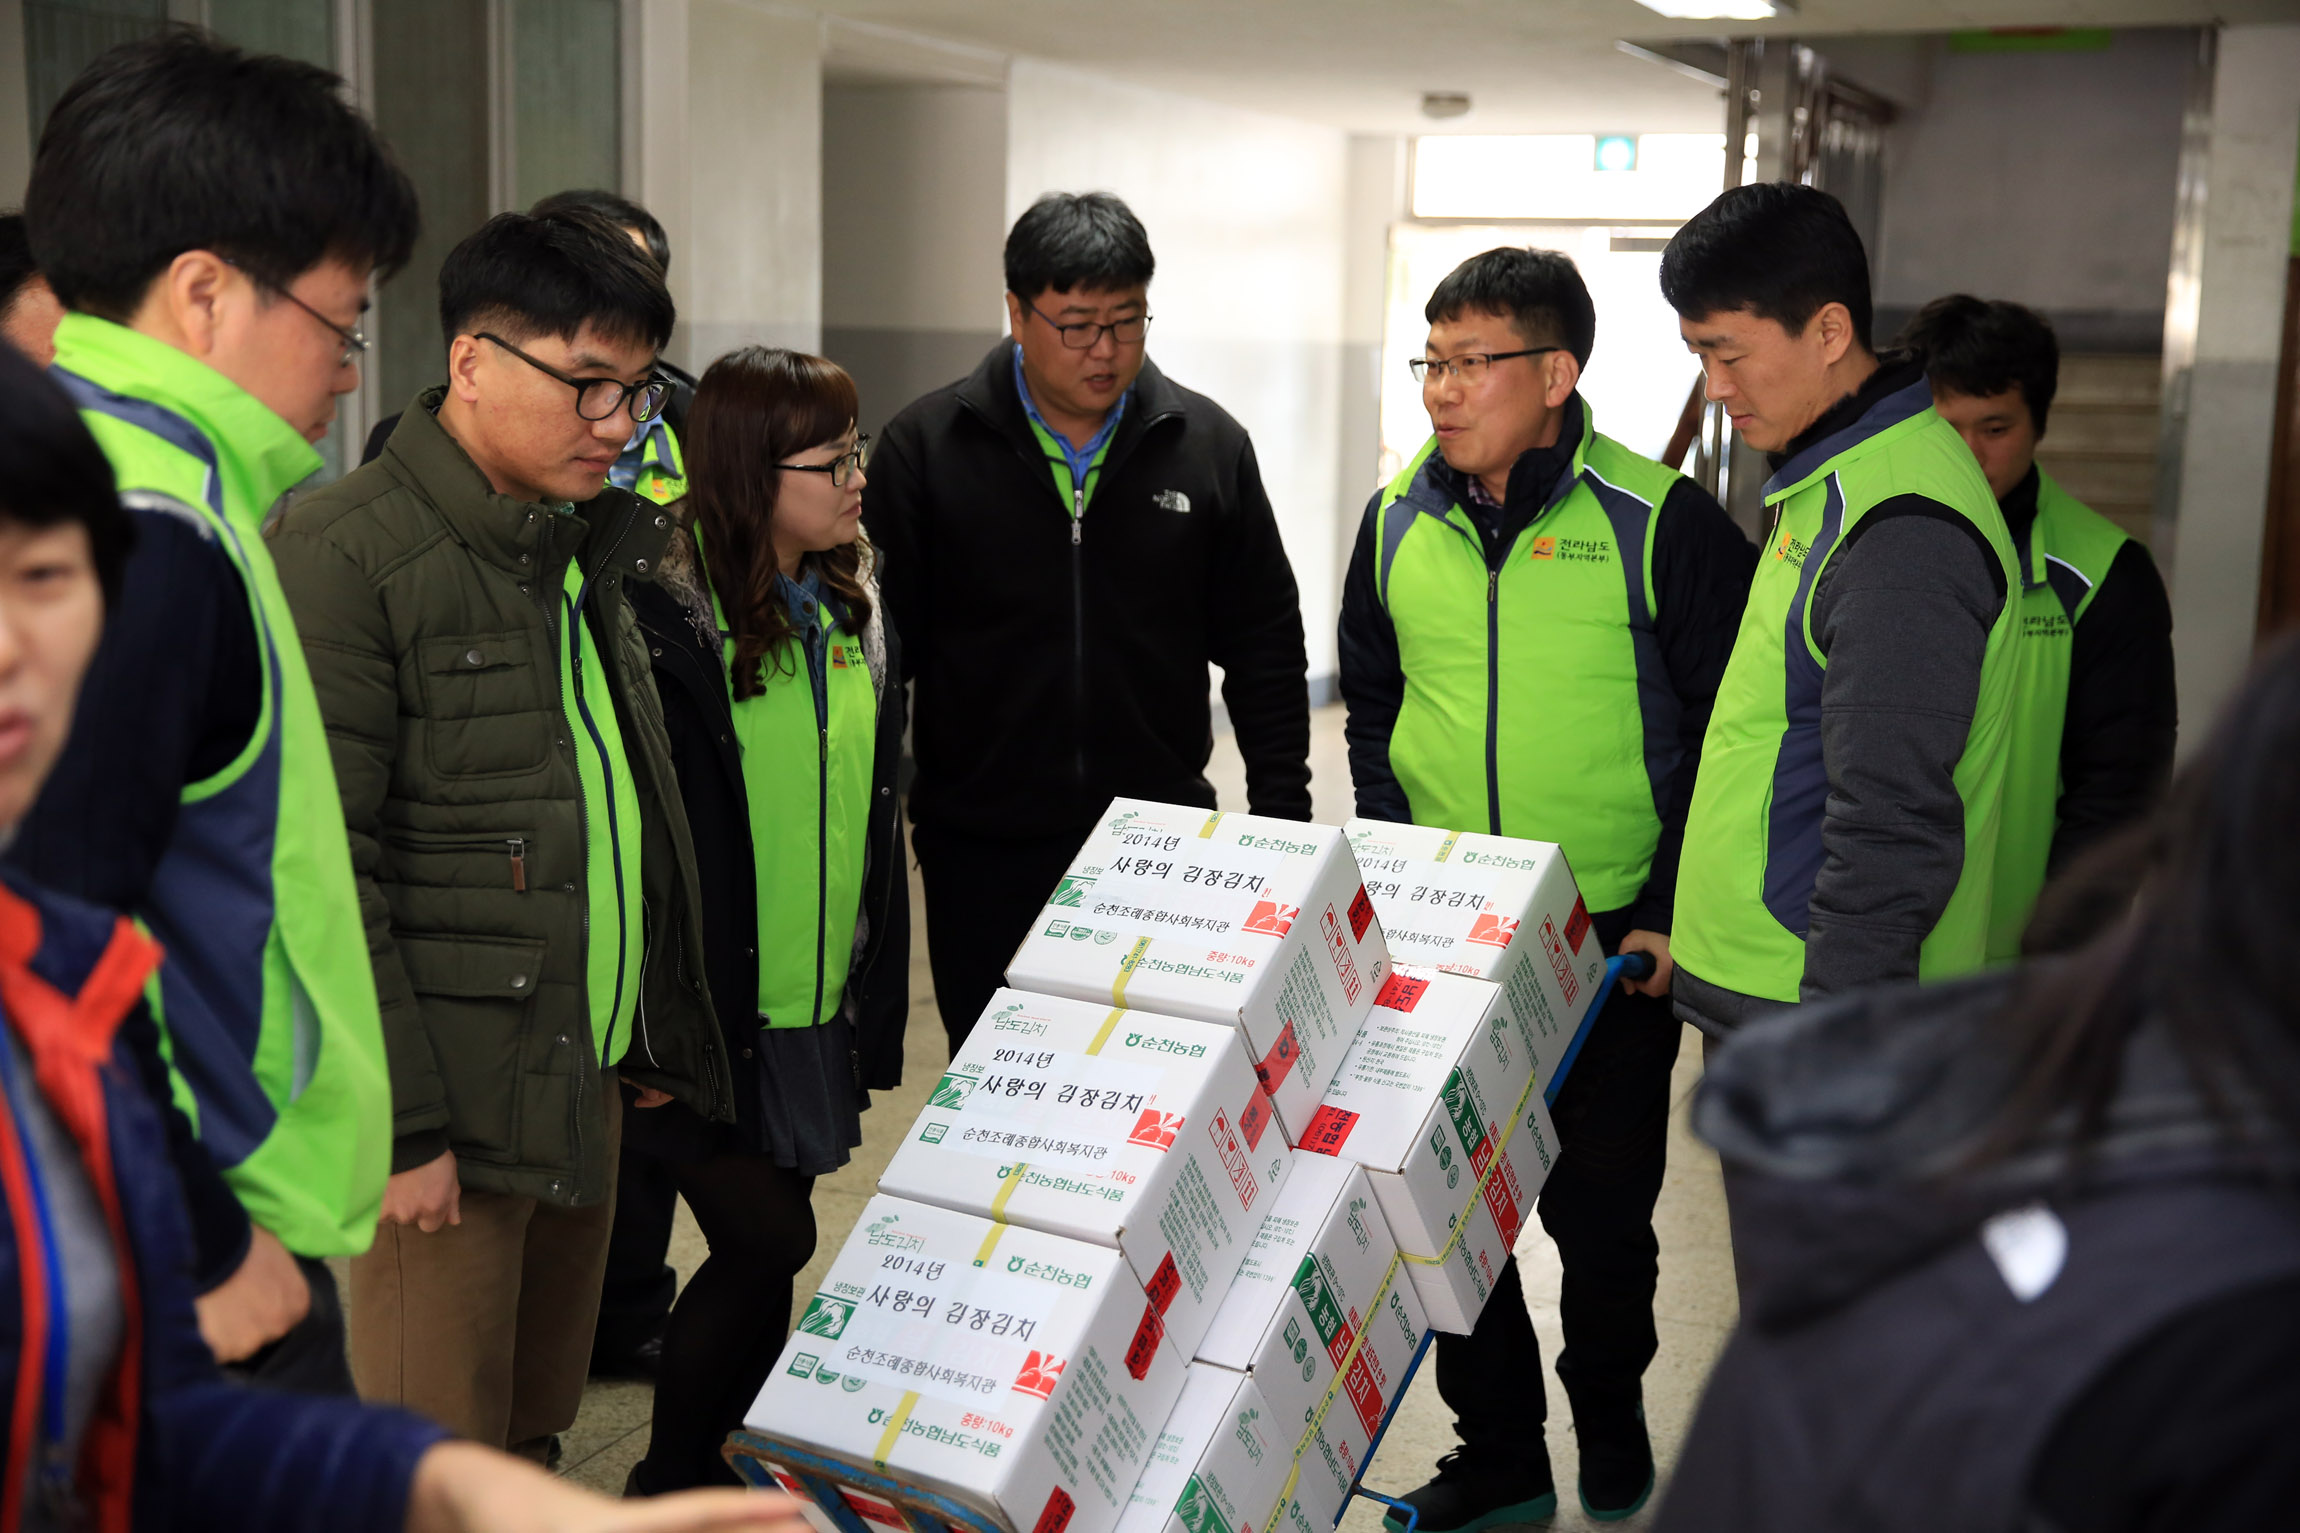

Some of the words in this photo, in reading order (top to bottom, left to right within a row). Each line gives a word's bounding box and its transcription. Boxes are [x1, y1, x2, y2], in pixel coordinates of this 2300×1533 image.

[1560, 538, 1610, 553] 전라남도
[1122, 832, 1182, 851] 2014년
[1254, 837, 1318, 857] 순천농협
[1110, 856, 1174, 879] 사랑의
[1183, 865, 1266, 893] 김장김치
[1477, 853, 1536, 872] 순천농협
[1366, 880, 1401, 900] 랑의
[1410, 886, 1485, 911] 김장김치
[1092, 902, 1231, 933] 순천조례종합사회복지관
[1380, 928, 1455, 949] 합사회복지관
[1207, 950, 1256, 968] 중량:10kg
[994, 1017, 1048, 1037] 남도김치
[992, 1048, 1056, 1069] 2014년
[1141, 1037, 1208, 1058] 순천농협
[980, 1075, 1048, 1101] 사랑의
[1056, 1083, 1145, 1114] 김장김치
[962, 1127, 1109, 1160] 순천조례종합사회복지관
[1462, 1115, 1479, 1150] 농협
[868, 1230, 925, 1253] 남도김치
[881, 1254, 946, 1281] 2014년
[1023, 1261, 1093, 1289] 순천농협
[1455, 1231, 1487, 1302] 천농협남도식품
[866, 1284, 936, 1318] 사랑의
[946, 1301, 1037, 1342] 김장김치
[1318, 1303, 1337, 1341] 농협
[1396, 1305, 1418, 1351] 순천농협
[846, 1345, 997, 1394] 순천조례종합사회복지관
[960, 1412, 1014, 1439] 중량:10kg
[1315, 1424, 1348, 1494] 천농협남도식품
